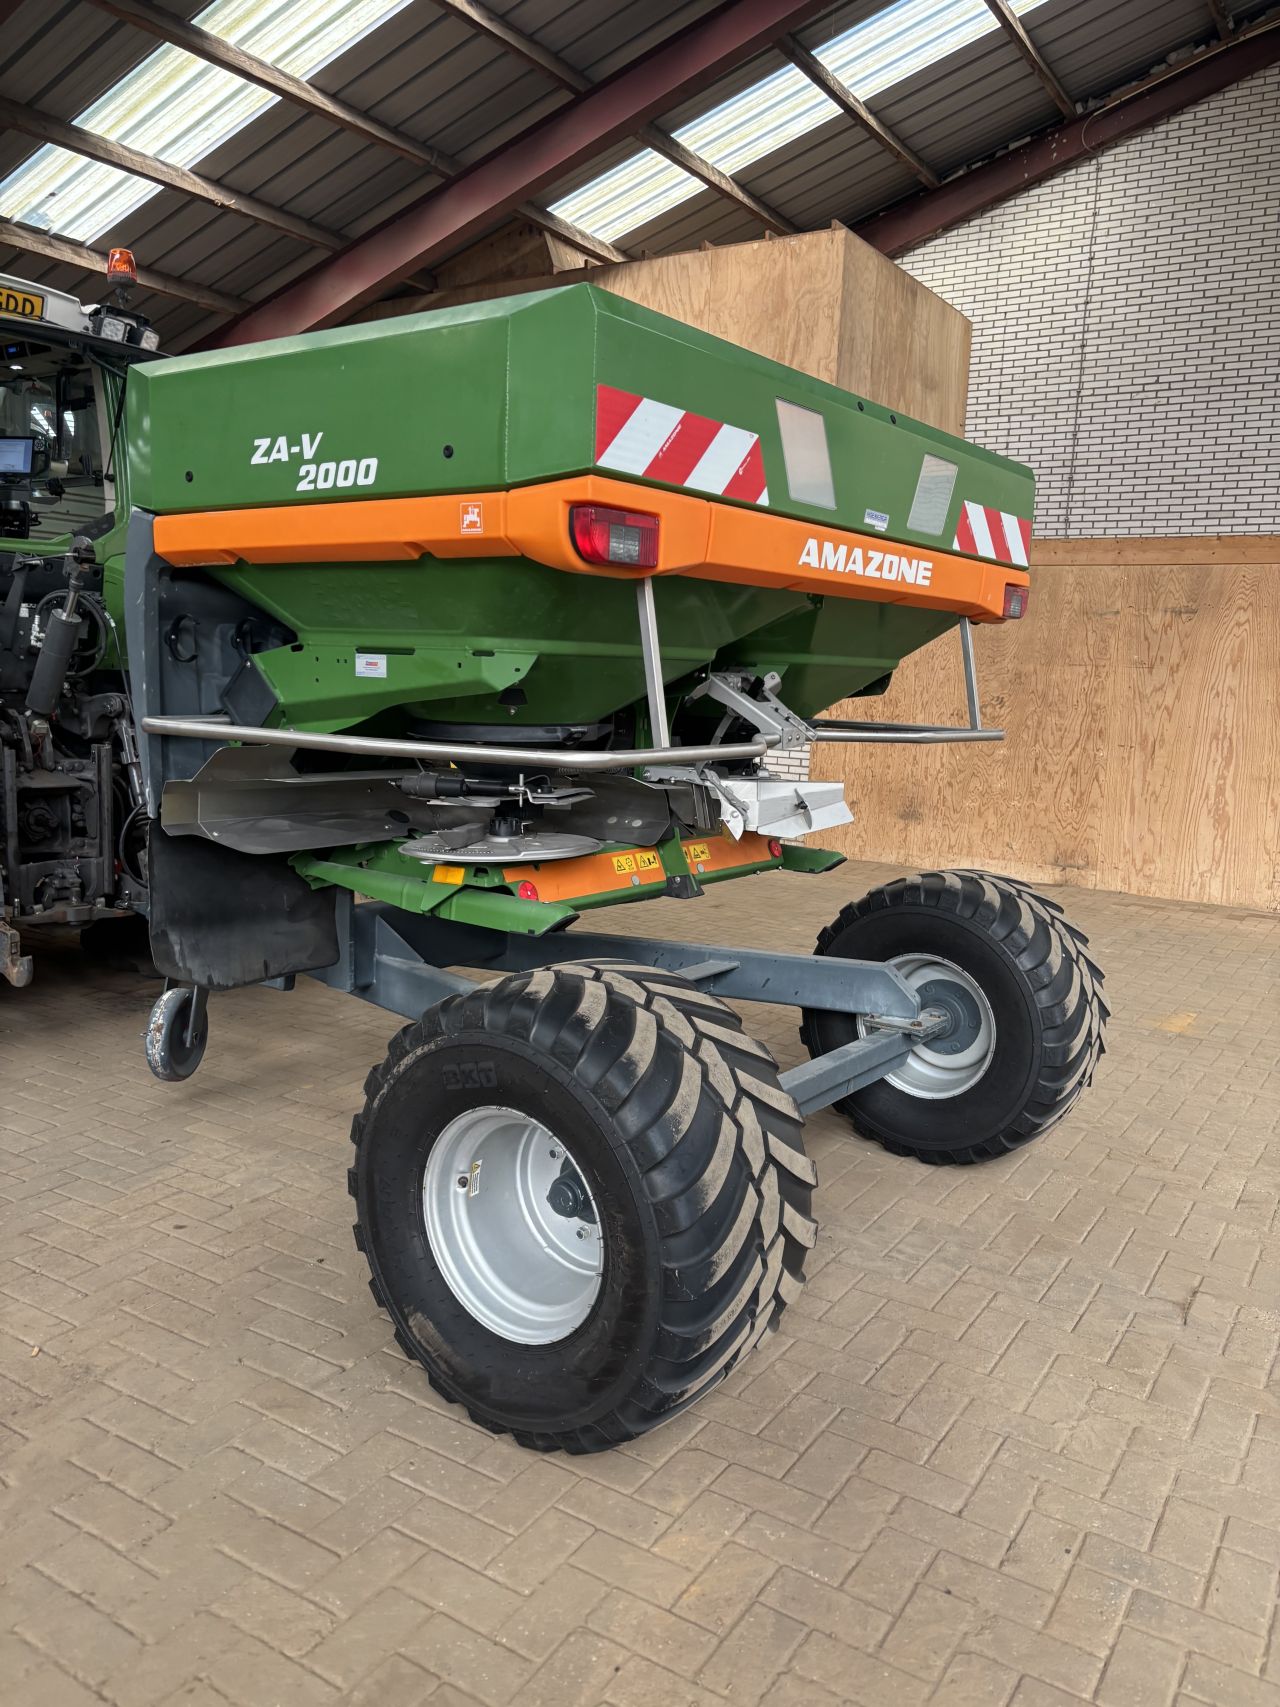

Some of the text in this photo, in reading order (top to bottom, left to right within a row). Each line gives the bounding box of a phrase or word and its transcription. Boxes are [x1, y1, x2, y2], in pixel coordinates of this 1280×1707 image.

[0, 290, 35, 316] DD
[250, 431, 324, 465] ZA-V
[296, 457, 378, 492] 2000
[798, 537, 933, 587] AMAZONE
[442, 1061, 498, 1090] BKT
